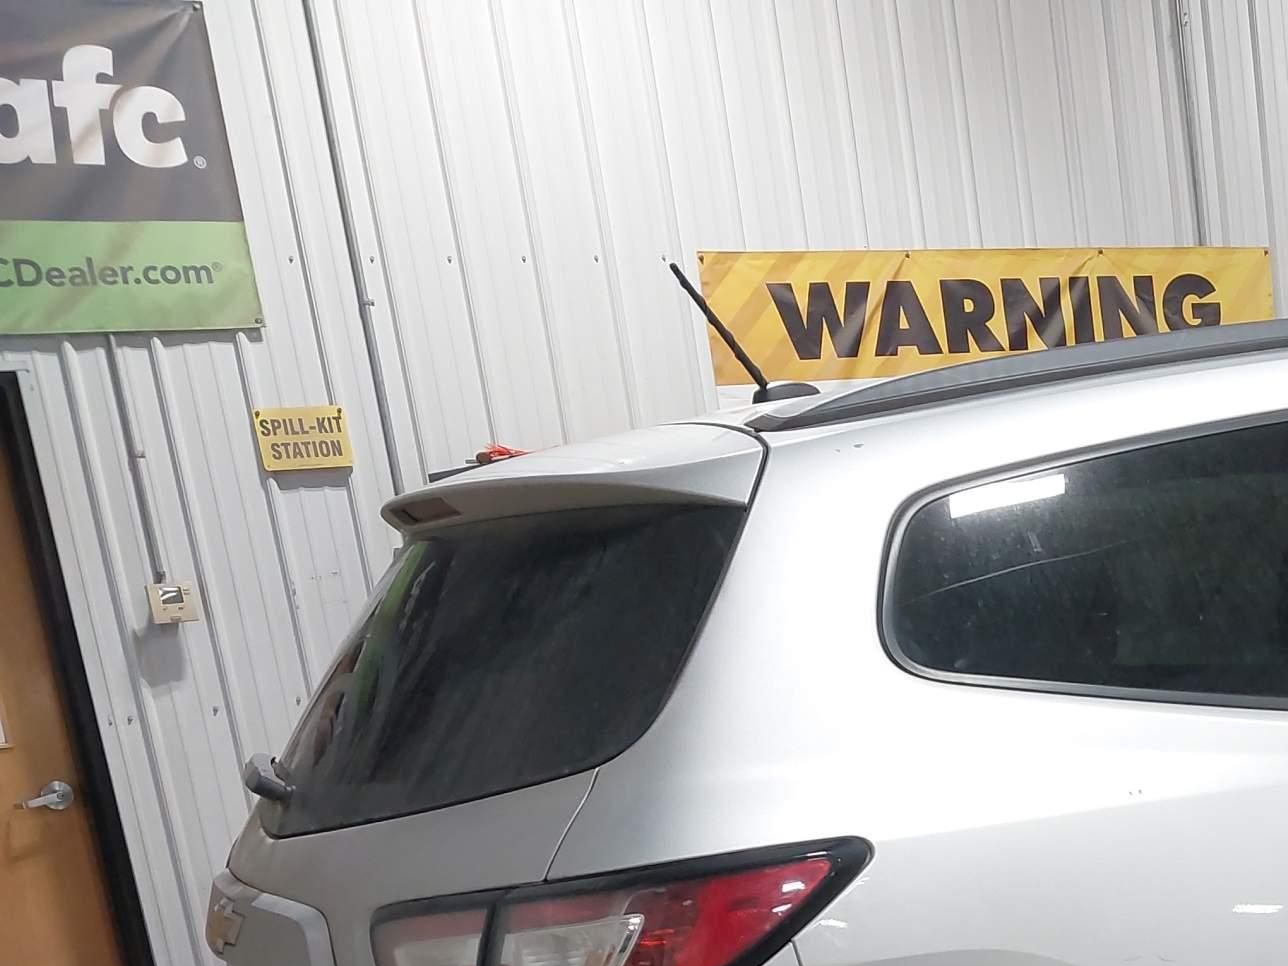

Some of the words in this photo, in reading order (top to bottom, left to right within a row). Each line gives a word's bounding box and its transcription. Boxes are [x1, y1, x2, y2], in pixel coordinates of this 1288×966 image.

[765, 272, 1222, 361] WARNING
[259, 416, 342, 437] SPILL-KIT
[270, 440, 343, 460] STATION
